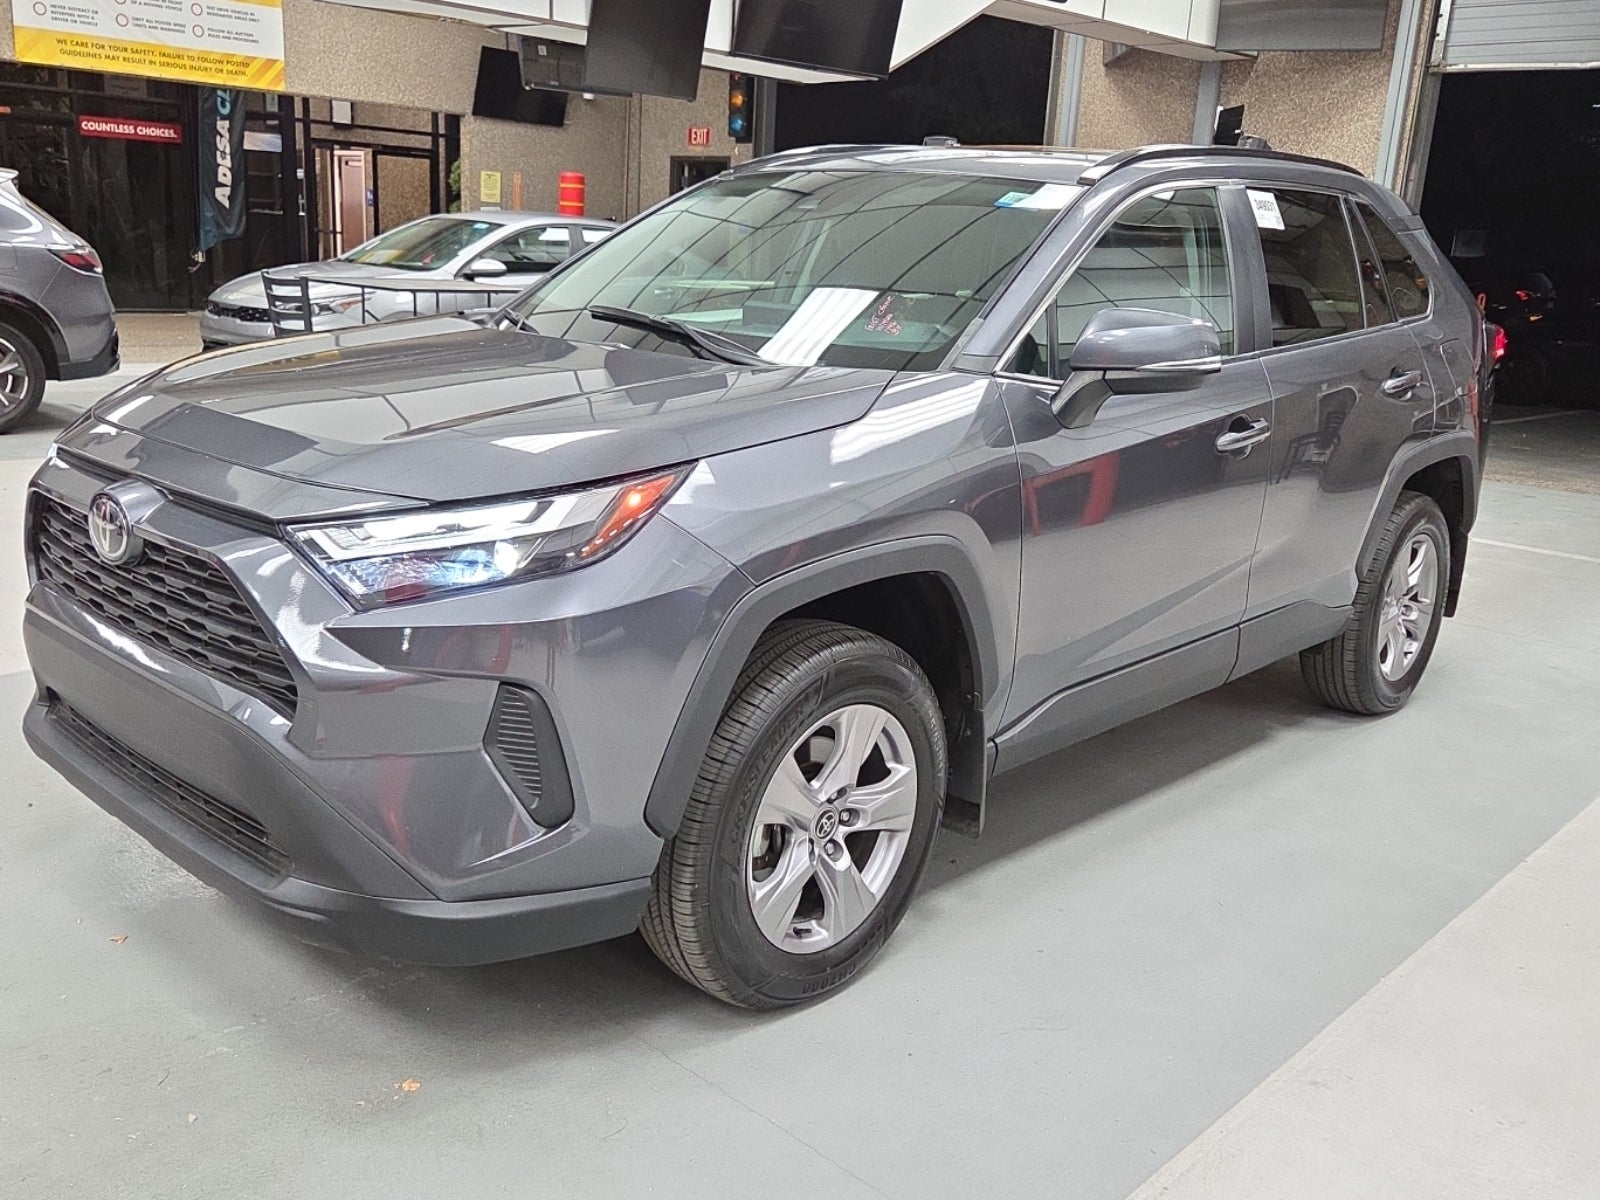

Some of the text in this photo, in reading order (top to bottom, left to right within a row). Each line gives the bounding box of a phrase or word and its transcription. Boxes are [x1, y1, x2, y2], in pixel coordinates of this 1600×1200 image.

[56, 38, 250, 69] WE CARE FOR YOUR SAFETY. FAILURE TO FOLLOW POSTED
[59, 48, 103, 60] GUIDELINES
[104, 54, 120, 62] MAY
[122, 56, 147, 65] RESULT
[158, 61, 187, 70] SERIOUS
[188, 64, 213, 73] INJURY
[214, 66, 224, 74] OR
[226, 68, 249, 77] DEATH.
[81, 120, 178, 138] COUNTLESS CHOICES.
[691, 128, 708, 145] EXIT
[214, 119, 233, 209] ADESA
